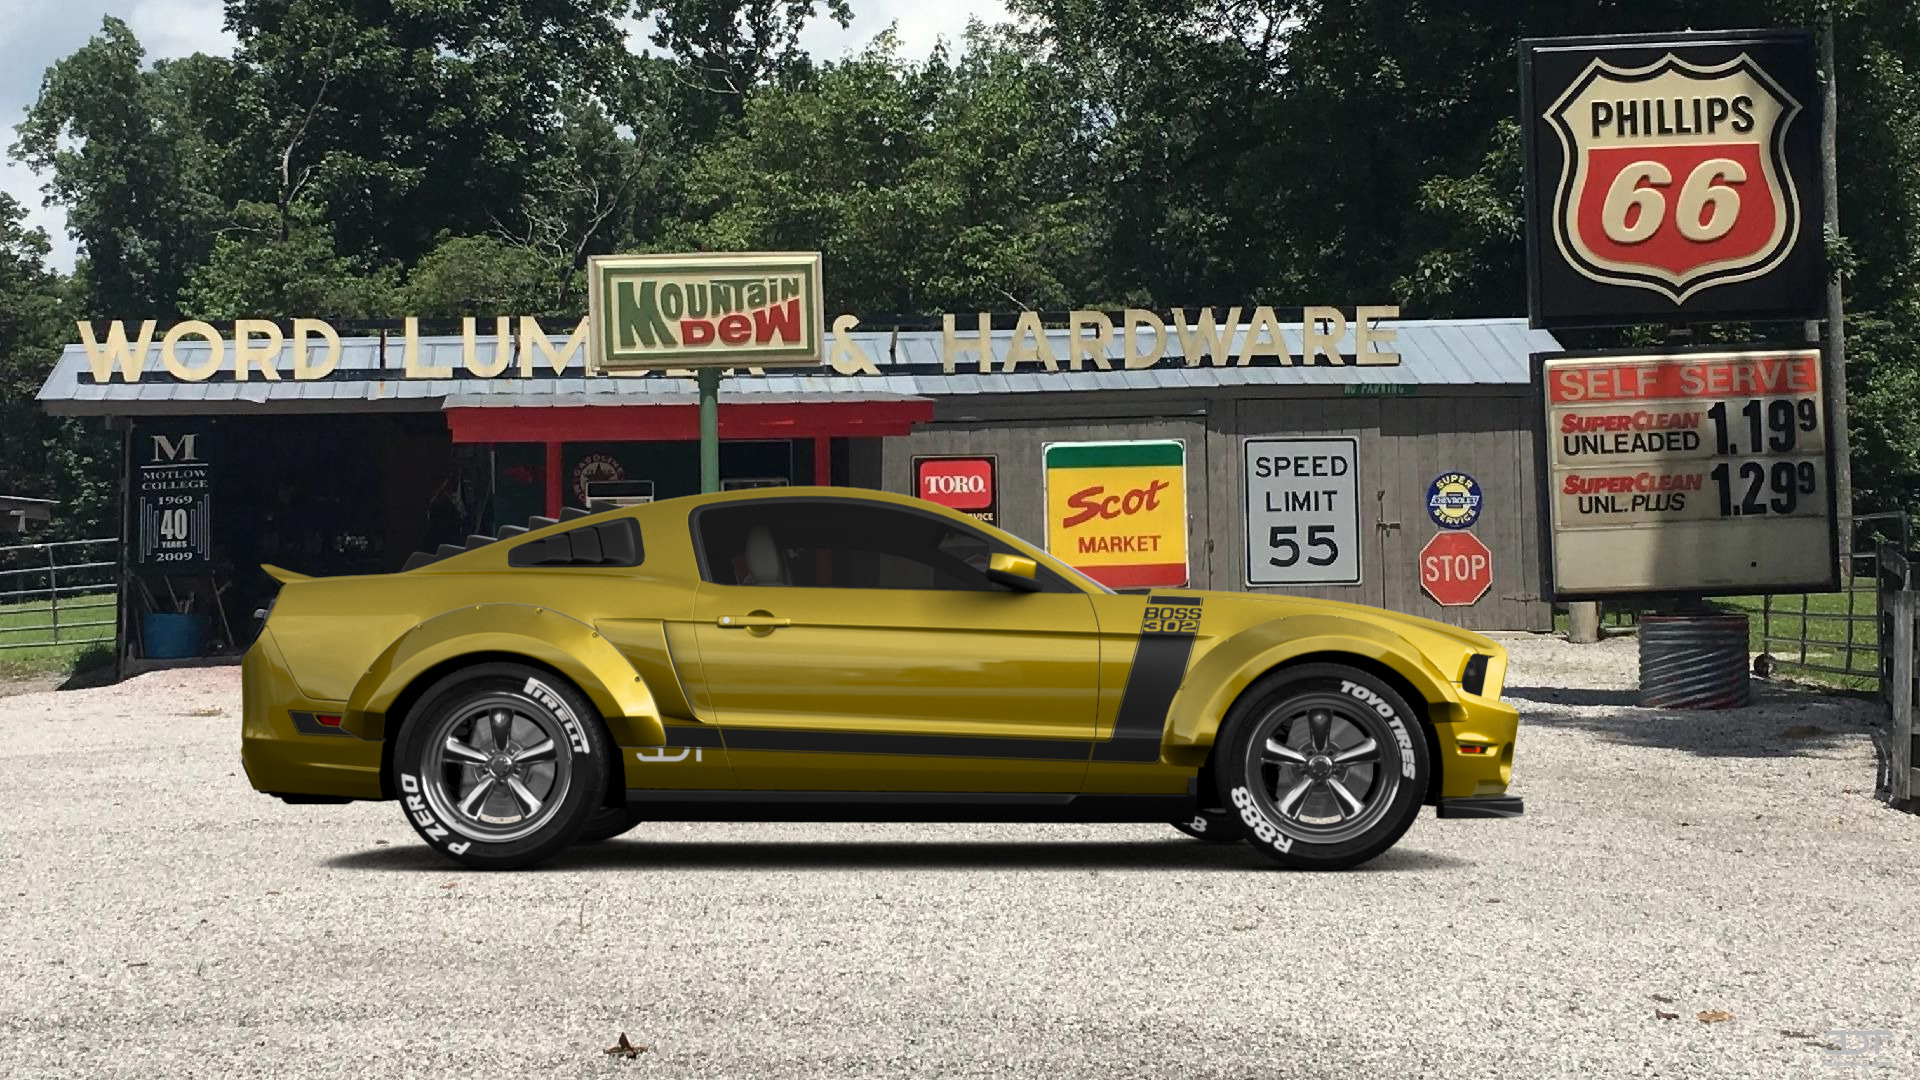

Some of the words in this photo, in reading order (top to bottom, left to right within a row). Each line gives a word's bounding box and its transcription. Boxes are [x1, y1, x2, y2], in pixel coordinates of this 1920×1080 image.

[1591, 96, 1755, 138] PHILLIPS
[1602, 158, 1748, 244] 66
[76, 318, 341, 383] WORD
[831, 314, 880, 375] &
[943, 305, 1401, 374] HARDWARE
[1559, 366, 1659, 400] SELF
[1679, 359, 1811, 395] SERVE
[150, 433, 199, 462] M
[1564, 430, 1700, 456] UNLEADED
[143, 469, 208, 480] MOTLOW
[1255, 456, 1348, 477] SPEED
[141, 480, 209, 491] COLLEGE
[1435, 474, 1474, 490] SUPER
[158, 495, 193, 505] 1969
[1063, 480, 1170, 528] Scot
[1266, 490, 1338, 512] LIMIT
[160, 508, 188, 540] 40
[1433, 509, 1476, 525] SERVICE
[155, 552, 193, 562] 2009
[162, 541, 188, 549] YEARS
[1078, 535, 1162, 554] MARKET
[1269, 525, 1339, 567] 55
[1425, 555, 1486, 582] STOP
[1143, 607, 1203, 620] BOSS
[1143, 620, 1197, 633] 302
[523, 677, 590, 754] PIRELLI
[1340, 680, 1395, 718] TOYO
[1388, 711, 1416, 781] TIRES
[401, 773, 449, 842] ZERO
[1231, 786, 1293, 854] R888
[448, 841, 471, 855] P
